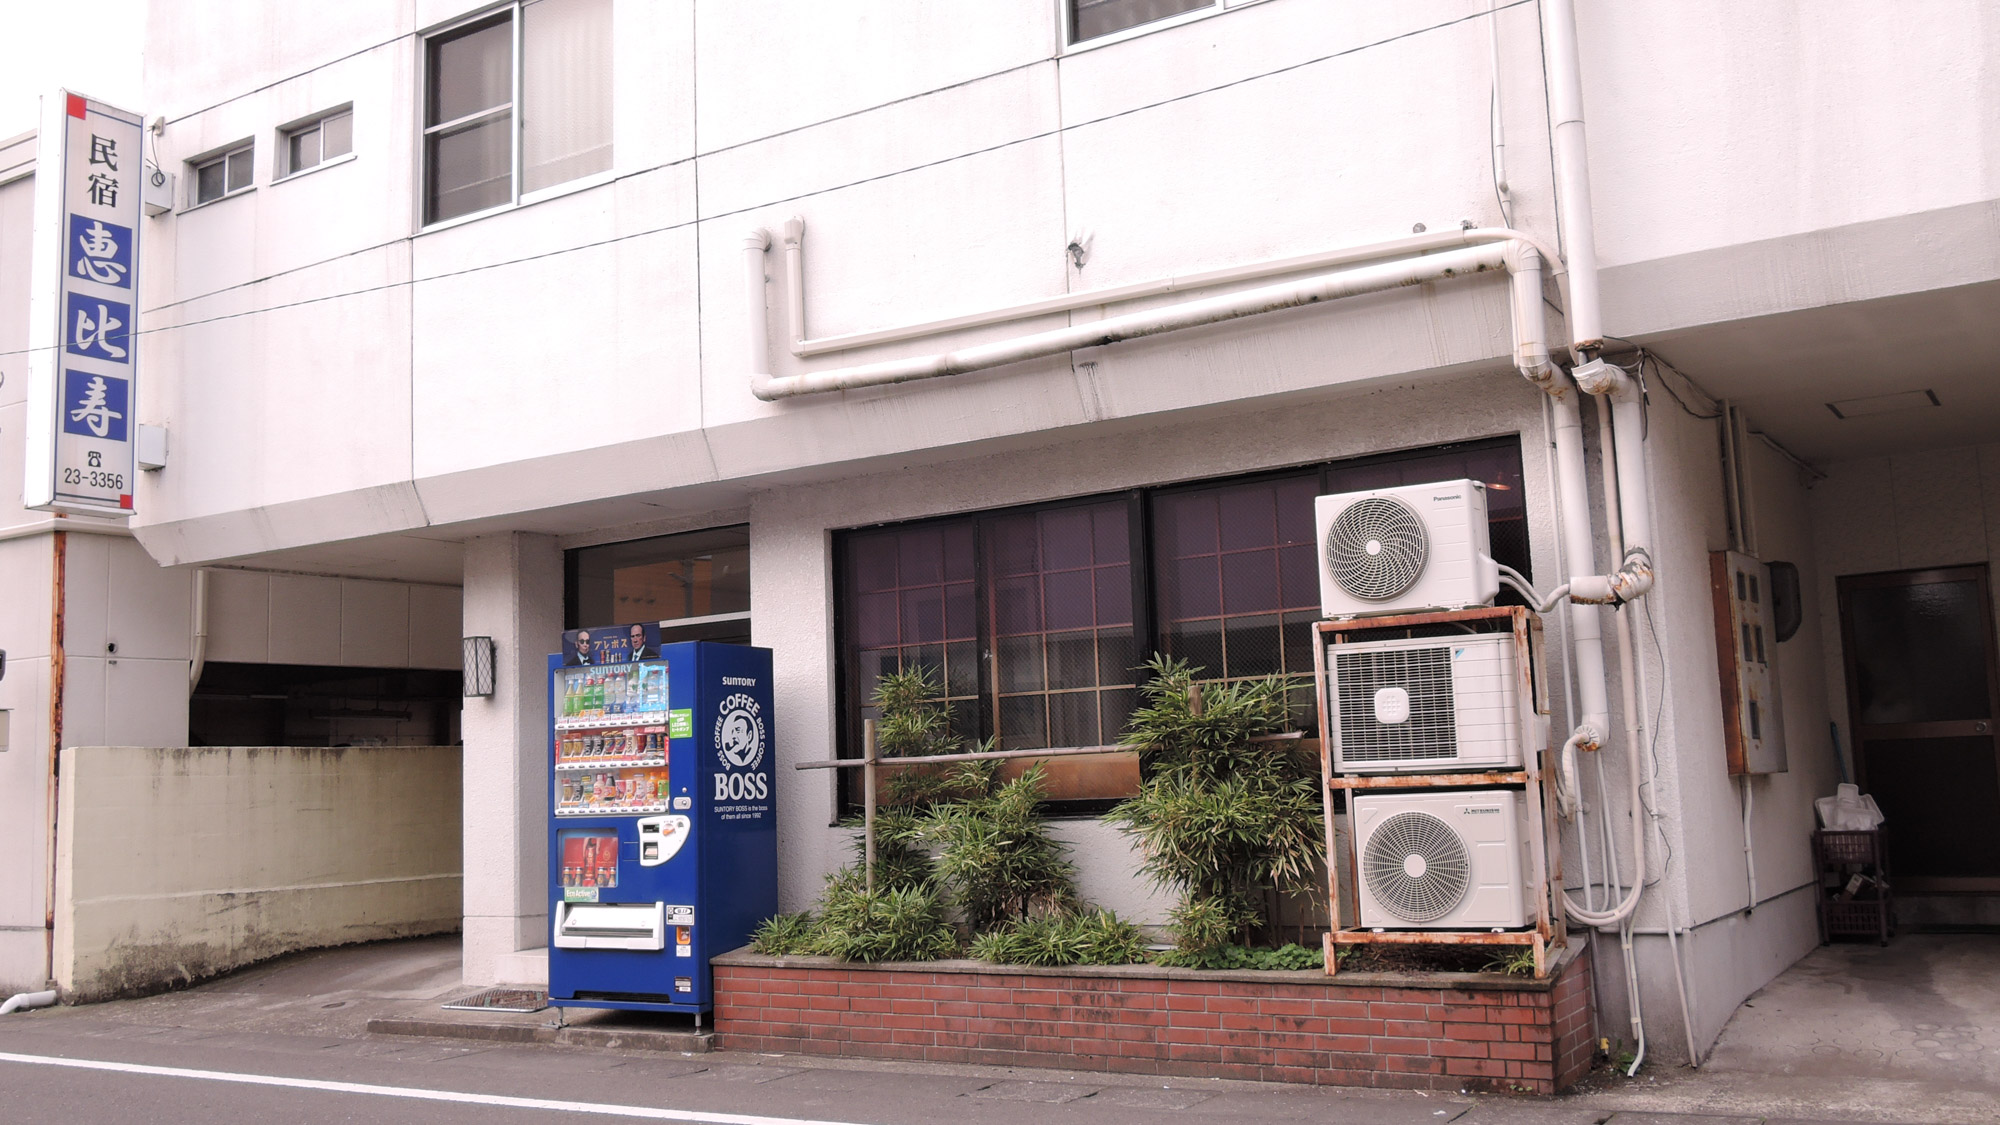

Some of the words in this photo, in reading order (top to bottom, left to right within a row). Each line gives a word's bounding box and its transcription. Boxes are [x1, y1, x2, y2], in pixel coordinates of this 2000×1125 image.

[87, 133, 119, 208] 民宿
[70, 221, 127, 438] 恵比寿
[64, 467, 124, 490] 23-3356
[590, 664, 633, 675] SUNTORY
[722, 676, 756, 686] SUNTORY
[719, 693, 760, 717] COFFEE
[714, 715, 724, 749] COFFEE
[714, 772, 768, 800] BOSS
